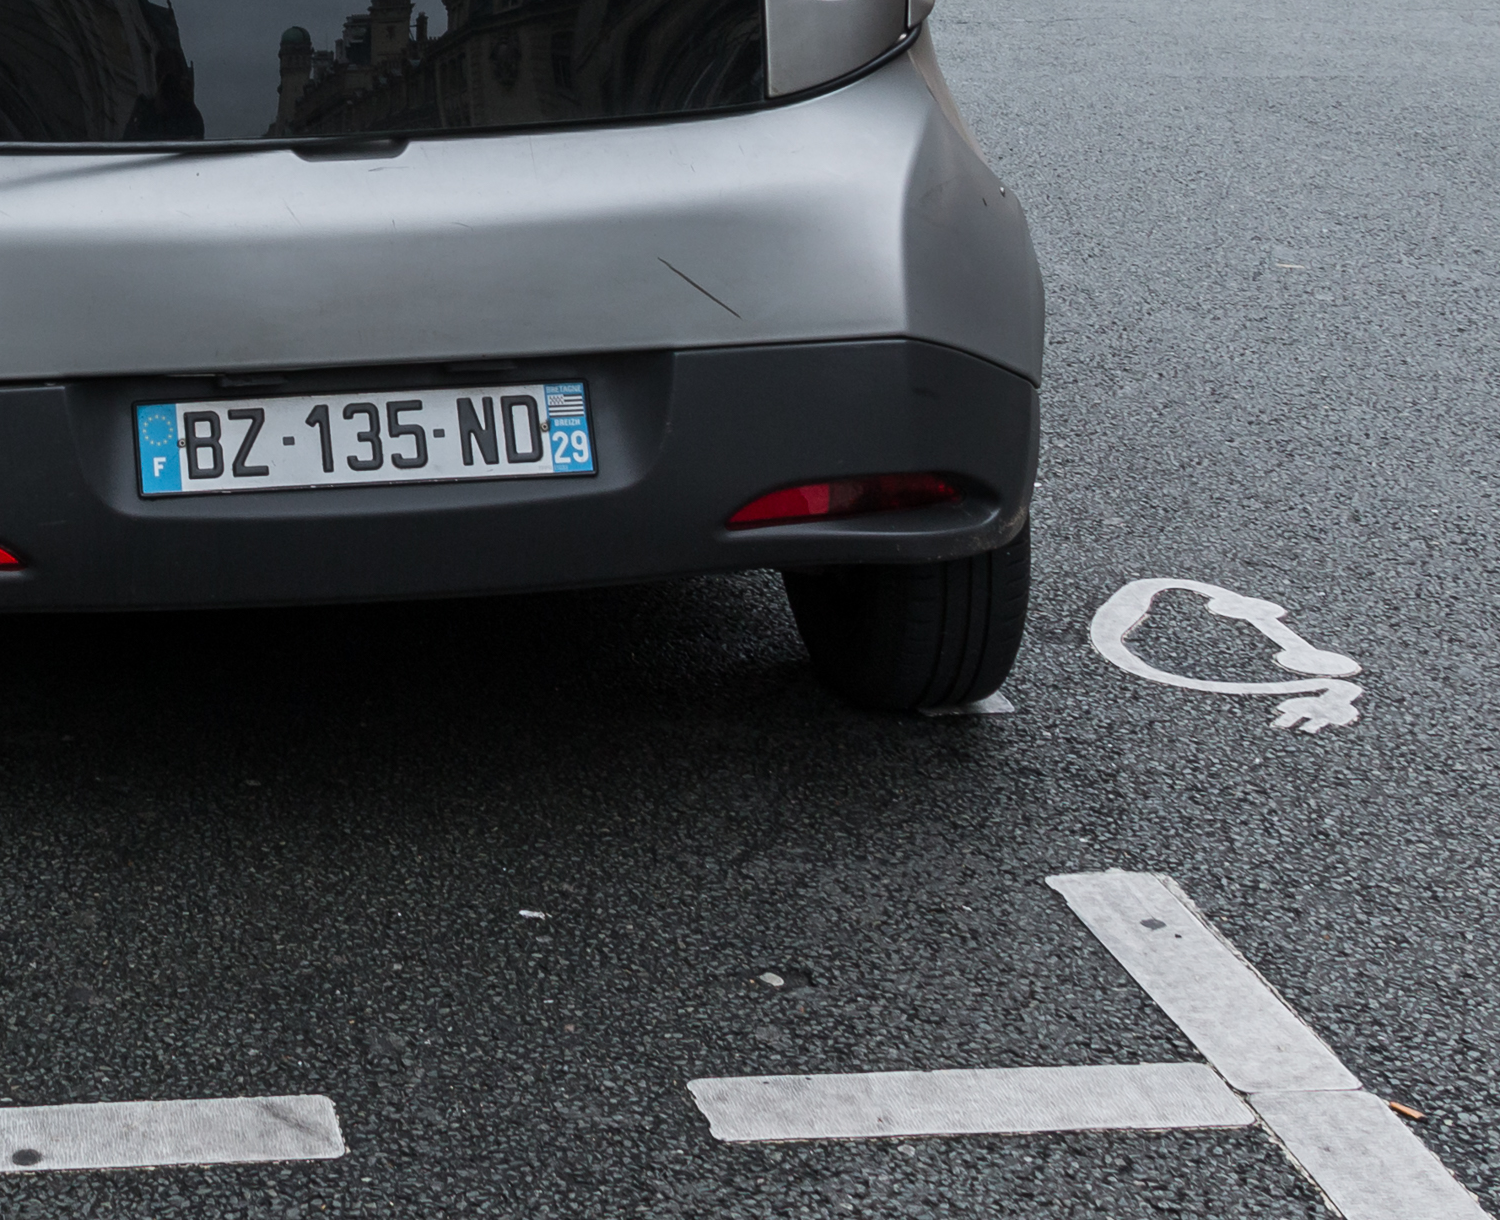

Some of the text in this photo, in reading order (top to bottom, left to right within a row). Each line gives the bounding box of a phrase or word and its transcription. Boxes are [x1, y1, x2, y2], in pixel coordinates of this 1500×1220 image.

[545, 385, 583, 394] BRETAGNE
[554, 418, 581, 427] BREIZH
[153, 457, 167, 477] F
[552, 430, 589, 464] 29
